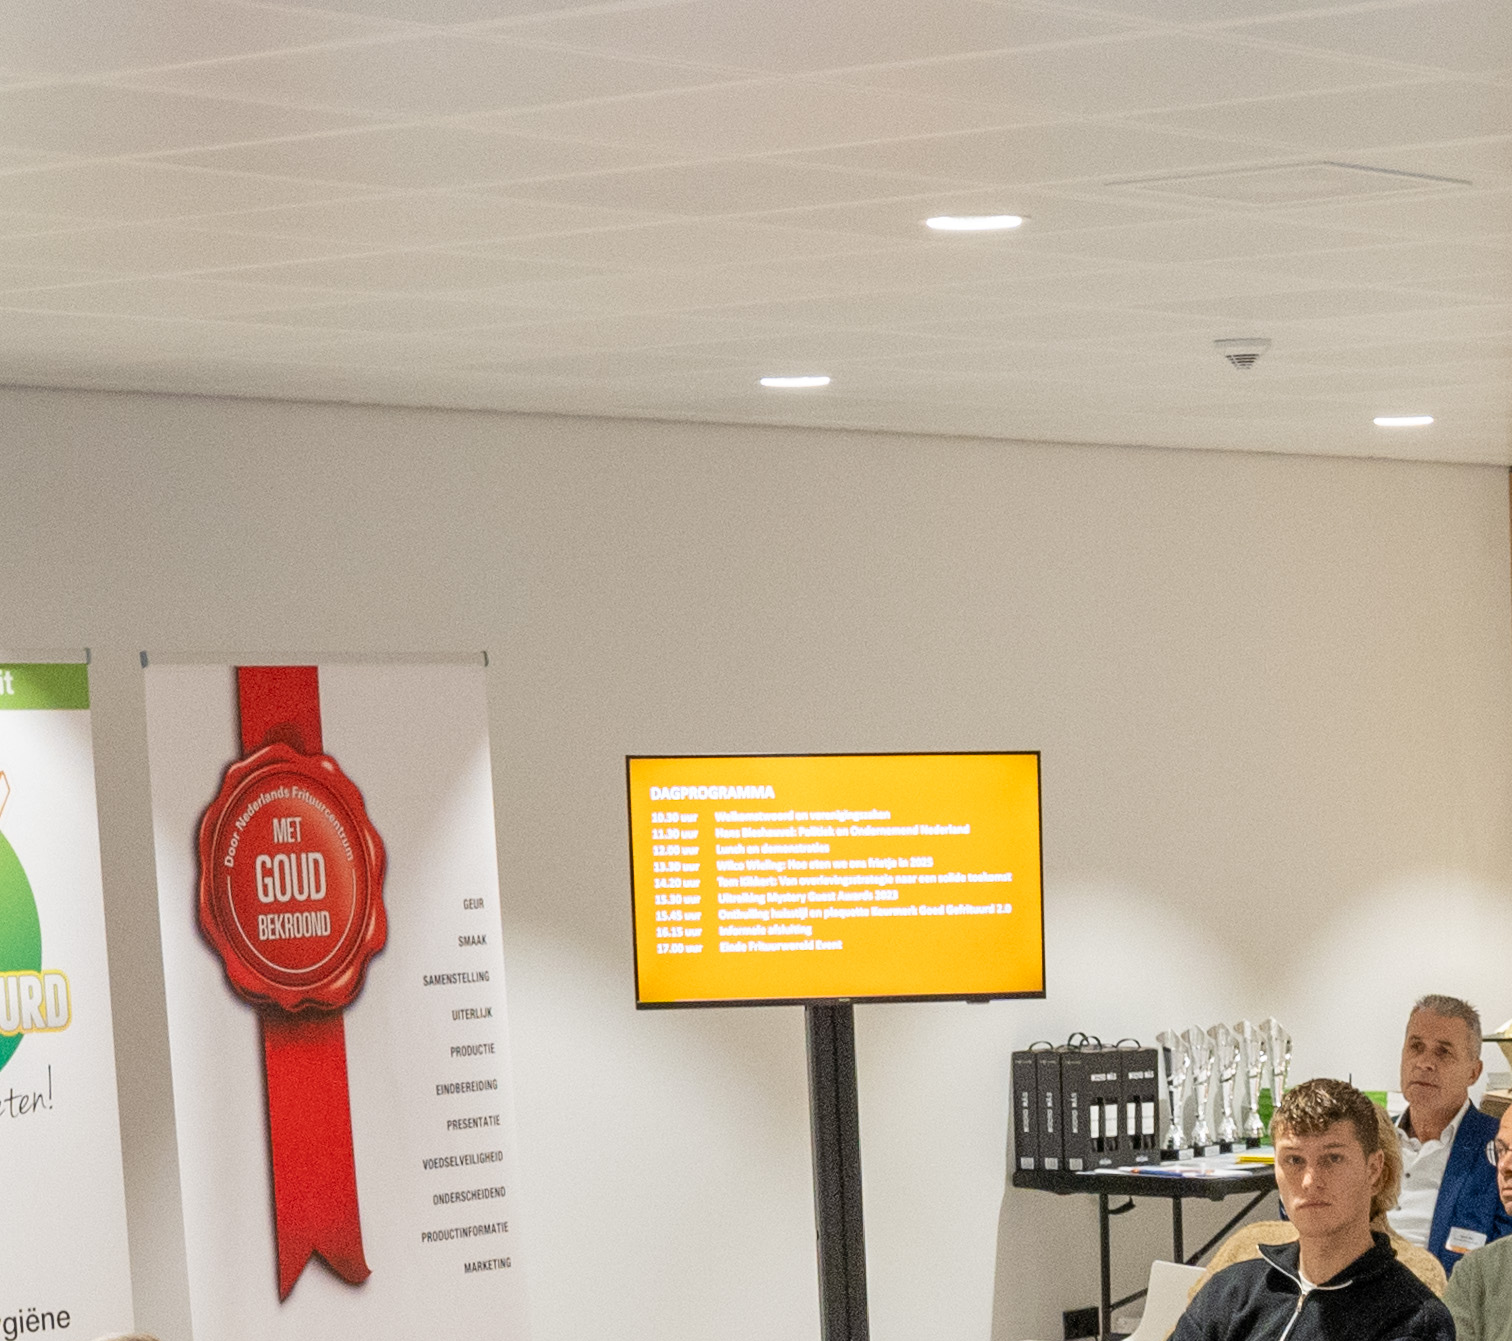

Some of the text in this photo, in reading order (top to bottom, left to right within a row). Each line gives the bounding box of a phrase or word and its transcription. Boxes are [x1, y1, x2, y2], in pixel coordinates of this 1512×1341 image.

[650, 785, 776, 801] DAGPROGRAMMA
[223, 785, 356, 868] Door Nederlands Frituurcentrum
[272, 817, 302, 843] MET
[254, 852, 326, 903] GOUD
[463, 897, 485, 911] GEUR
[257, 910, 331, 941] BEKROOND
[458, 934, 487, 947] SMAAK
[422, 970, 490, 987] SAMENSTELLING
[451, 1007, 492, 1021] UITERLIJK
[450, 1042, 495, 1058] PRODUCTIE
[435, 1079, 498, 1096] EINDBEREIDING
[446, 1114, 501, 1131] PRESENTATIE
[422, 1150, 503, 1170] VOEDSELVEILIGHEID
[432, 1186, 506, 1205] ONDERSCHEIDEND
[421, 1222, 509, 1243] PRODUCTINFORMATIE
[463, 1257, 512, 1275] MARKETING
